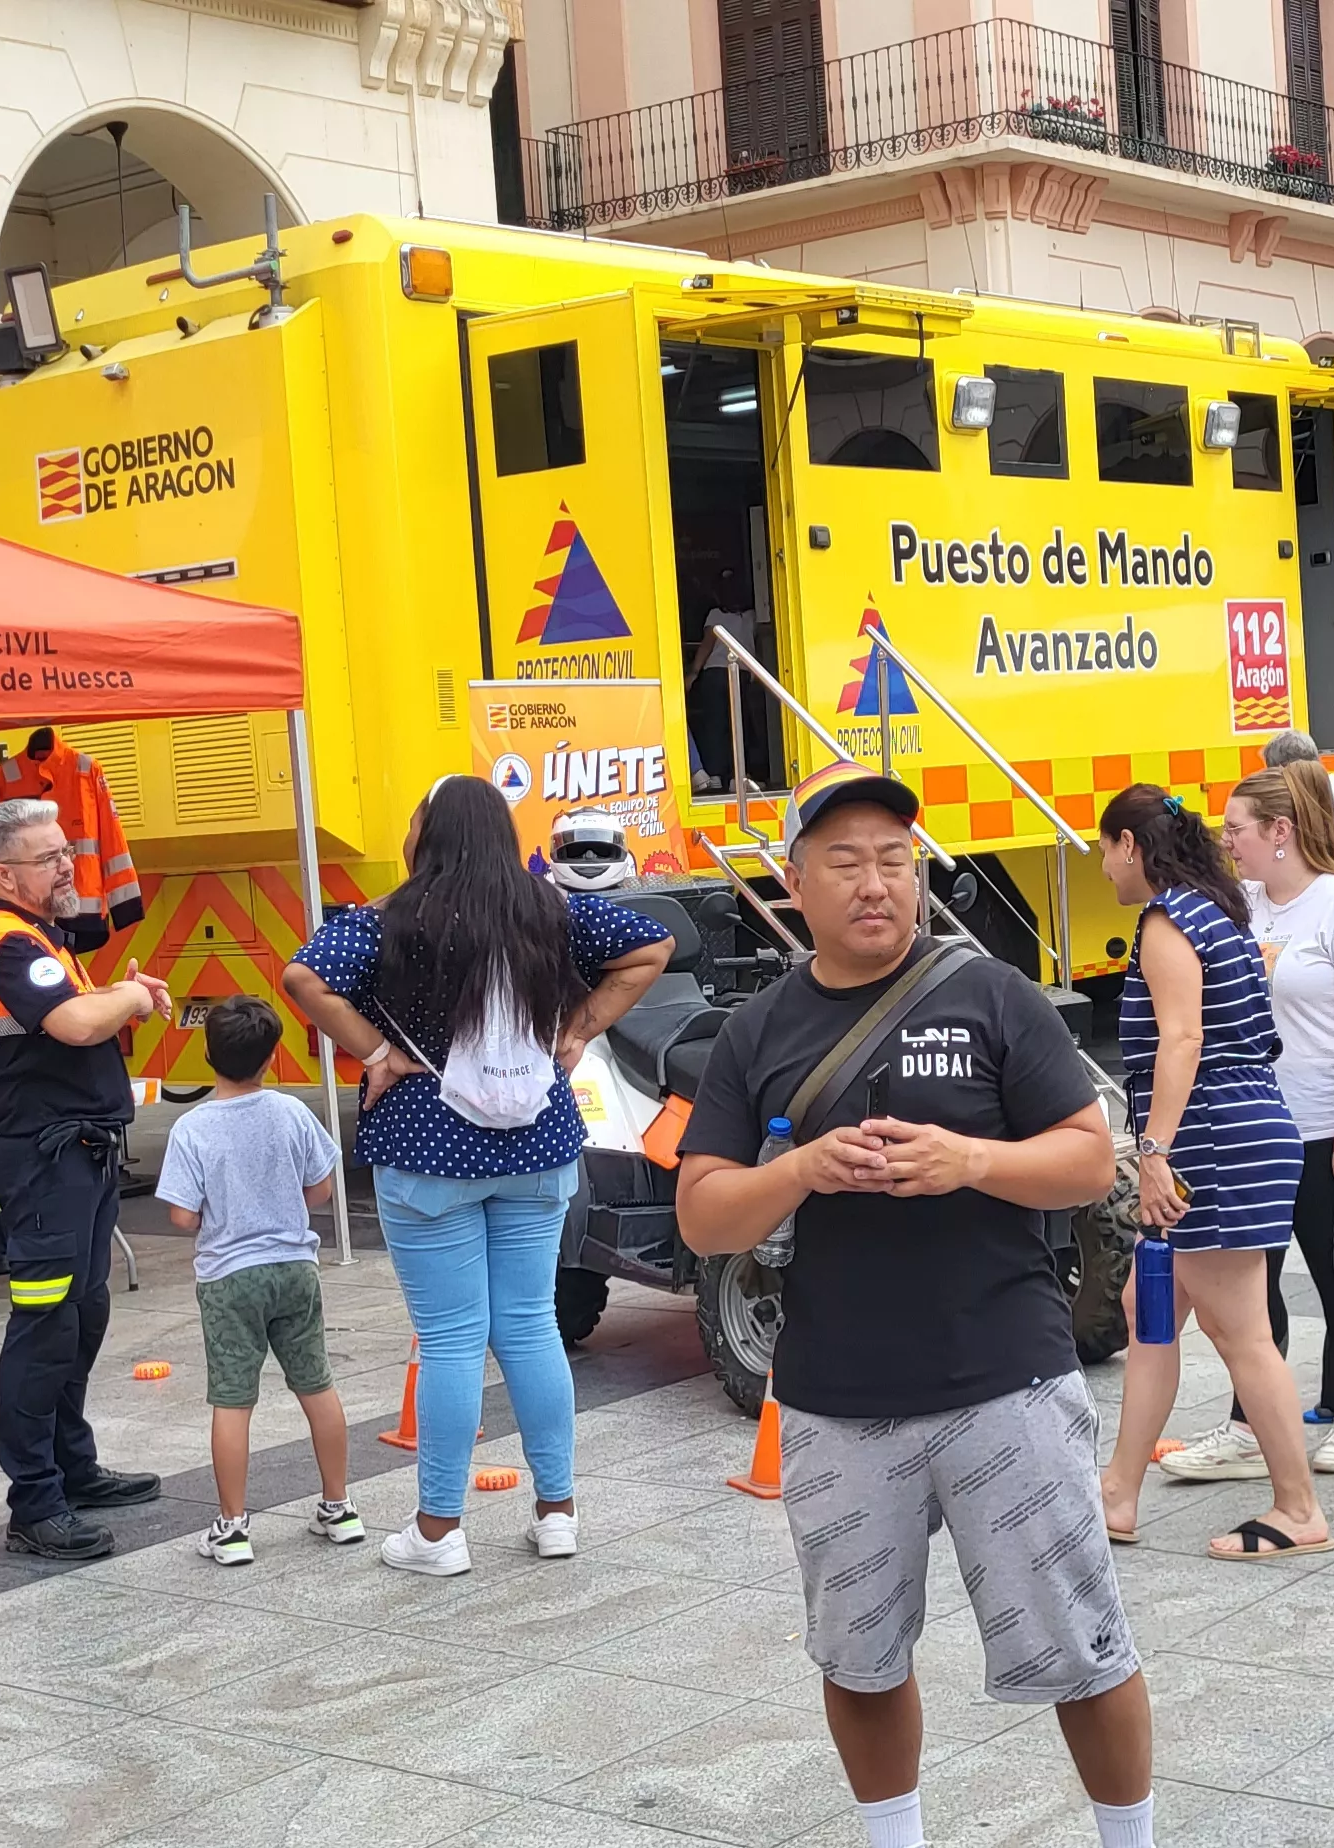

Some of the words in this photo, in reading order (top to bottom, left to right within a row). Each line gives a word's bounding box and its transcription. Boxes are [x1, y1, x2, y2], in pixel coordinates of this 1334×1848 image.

[83, 425, 214, 478] GOBIERNO
[85, 479, 118, 514] DE
[126, 457, 236, 507] ARAGON
[890, 523, 1030, 585] Puesto
[1042, 528, 1087, 585] de
[1097, 531, 1214, 586] Mando
[975, 615, 1158, 674] Avanzado
[1232, 610, 1283, 656] 112
[0, 667, 33, 692] de
[41, 666, 134, 691] Huesca
[517, 652, 601, 679] PROTECCION
[603, 650, 636, 679] CIVIL
[1235, 660, 1285, 694] Aragón
[509, 703, 566, 716] GOBIERNO
[510, 717, 526, 730] DE
[530, 716, 577, 729] ARAGON
[837, 725, 898, 758] PROTECCN
[900, 725, 923, 755] CIVIL
[542, 740, 667, 802] ÚNETE
[610, 798, 644, 814] EQUIPO
[646, 796, 659, 809] DE
[618, 808, 658, 828] ECCIÓN
[638, 822, 666, 838] CIVIL
[901, 1027, 971, 1049] دبي
[902, 1053, 973, 1078] DUBAI
